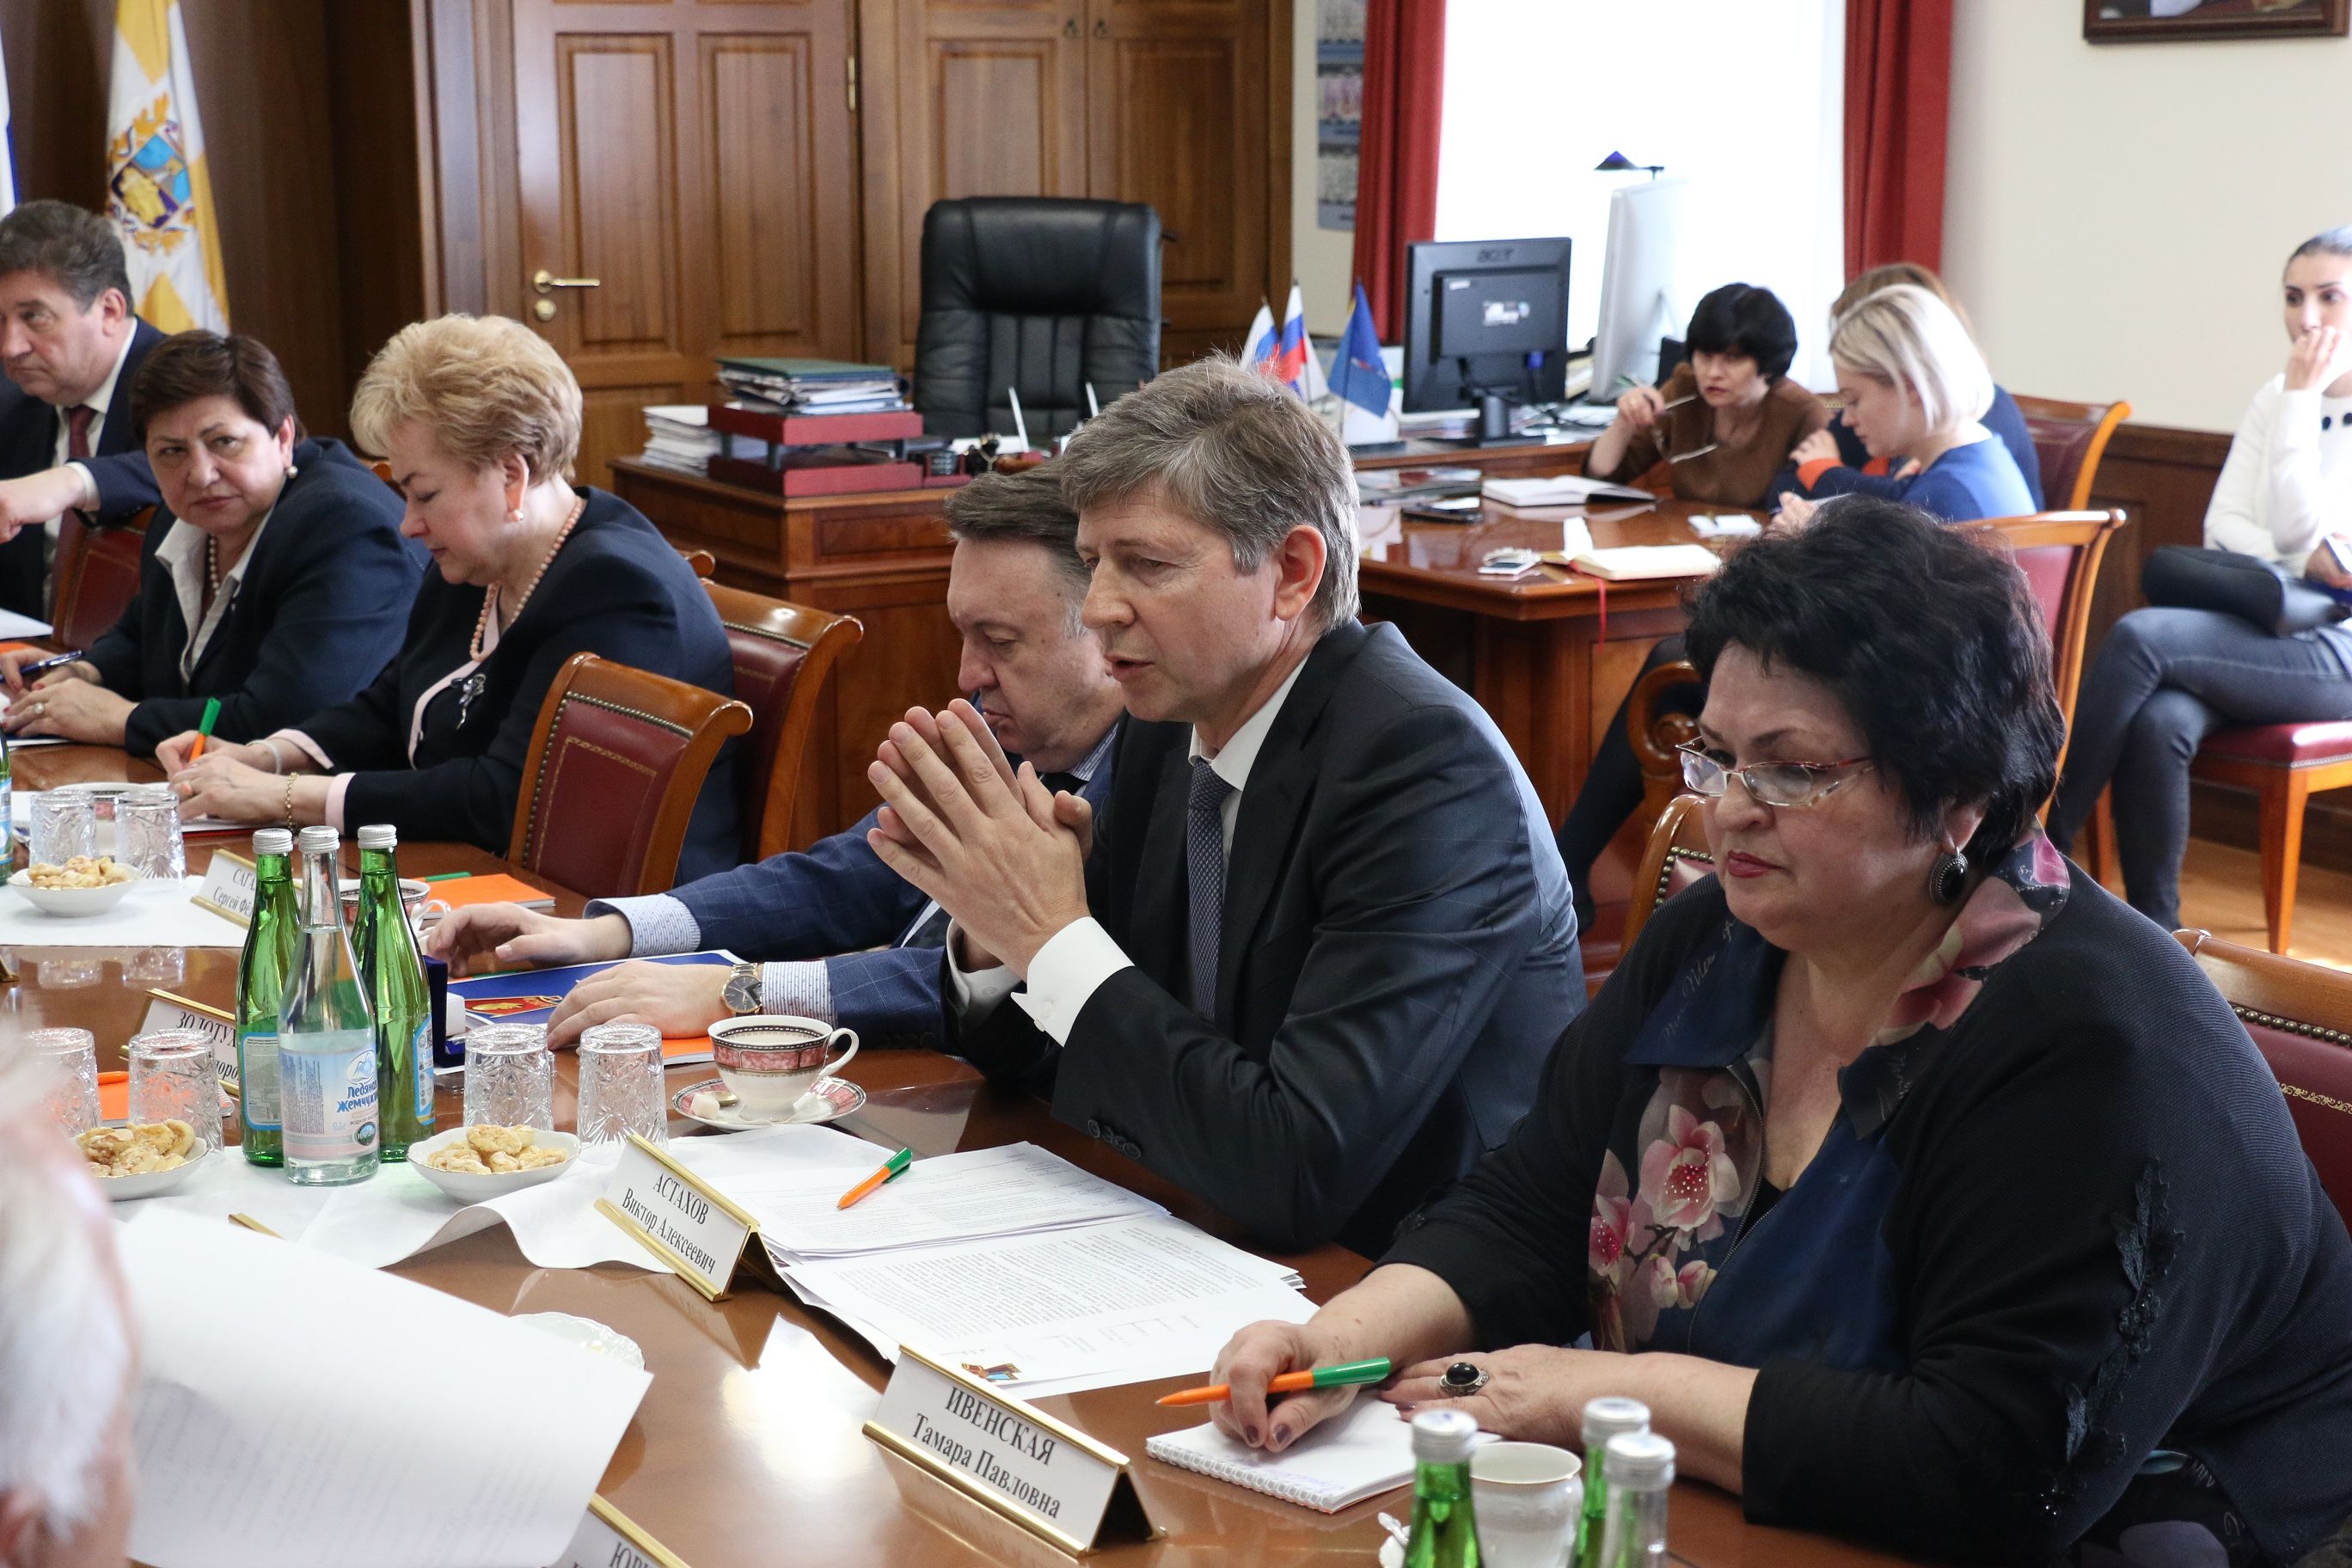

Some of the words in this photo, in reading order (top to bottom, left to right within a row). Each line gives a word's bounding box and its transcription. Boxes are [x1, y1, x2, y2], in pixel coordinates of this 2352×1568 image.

[213, 886, 240, 910] Сергей
[233, 868, 255, 891] САГА
[175, 1011, 236, 1048] ЗОЛОТУХ
[652, 1173, 709, 1225] АСТАХОВ
[622, 1188, 658, 1234] Виктор
[656, 1217, 716, 1275] Алексеевич
[945, 1387, 1057, 1466] ИВЕНСКАЯ
[913, 1412, 972, 1468] Тамара
[974, 1449, 1061, 1519] Павловна
